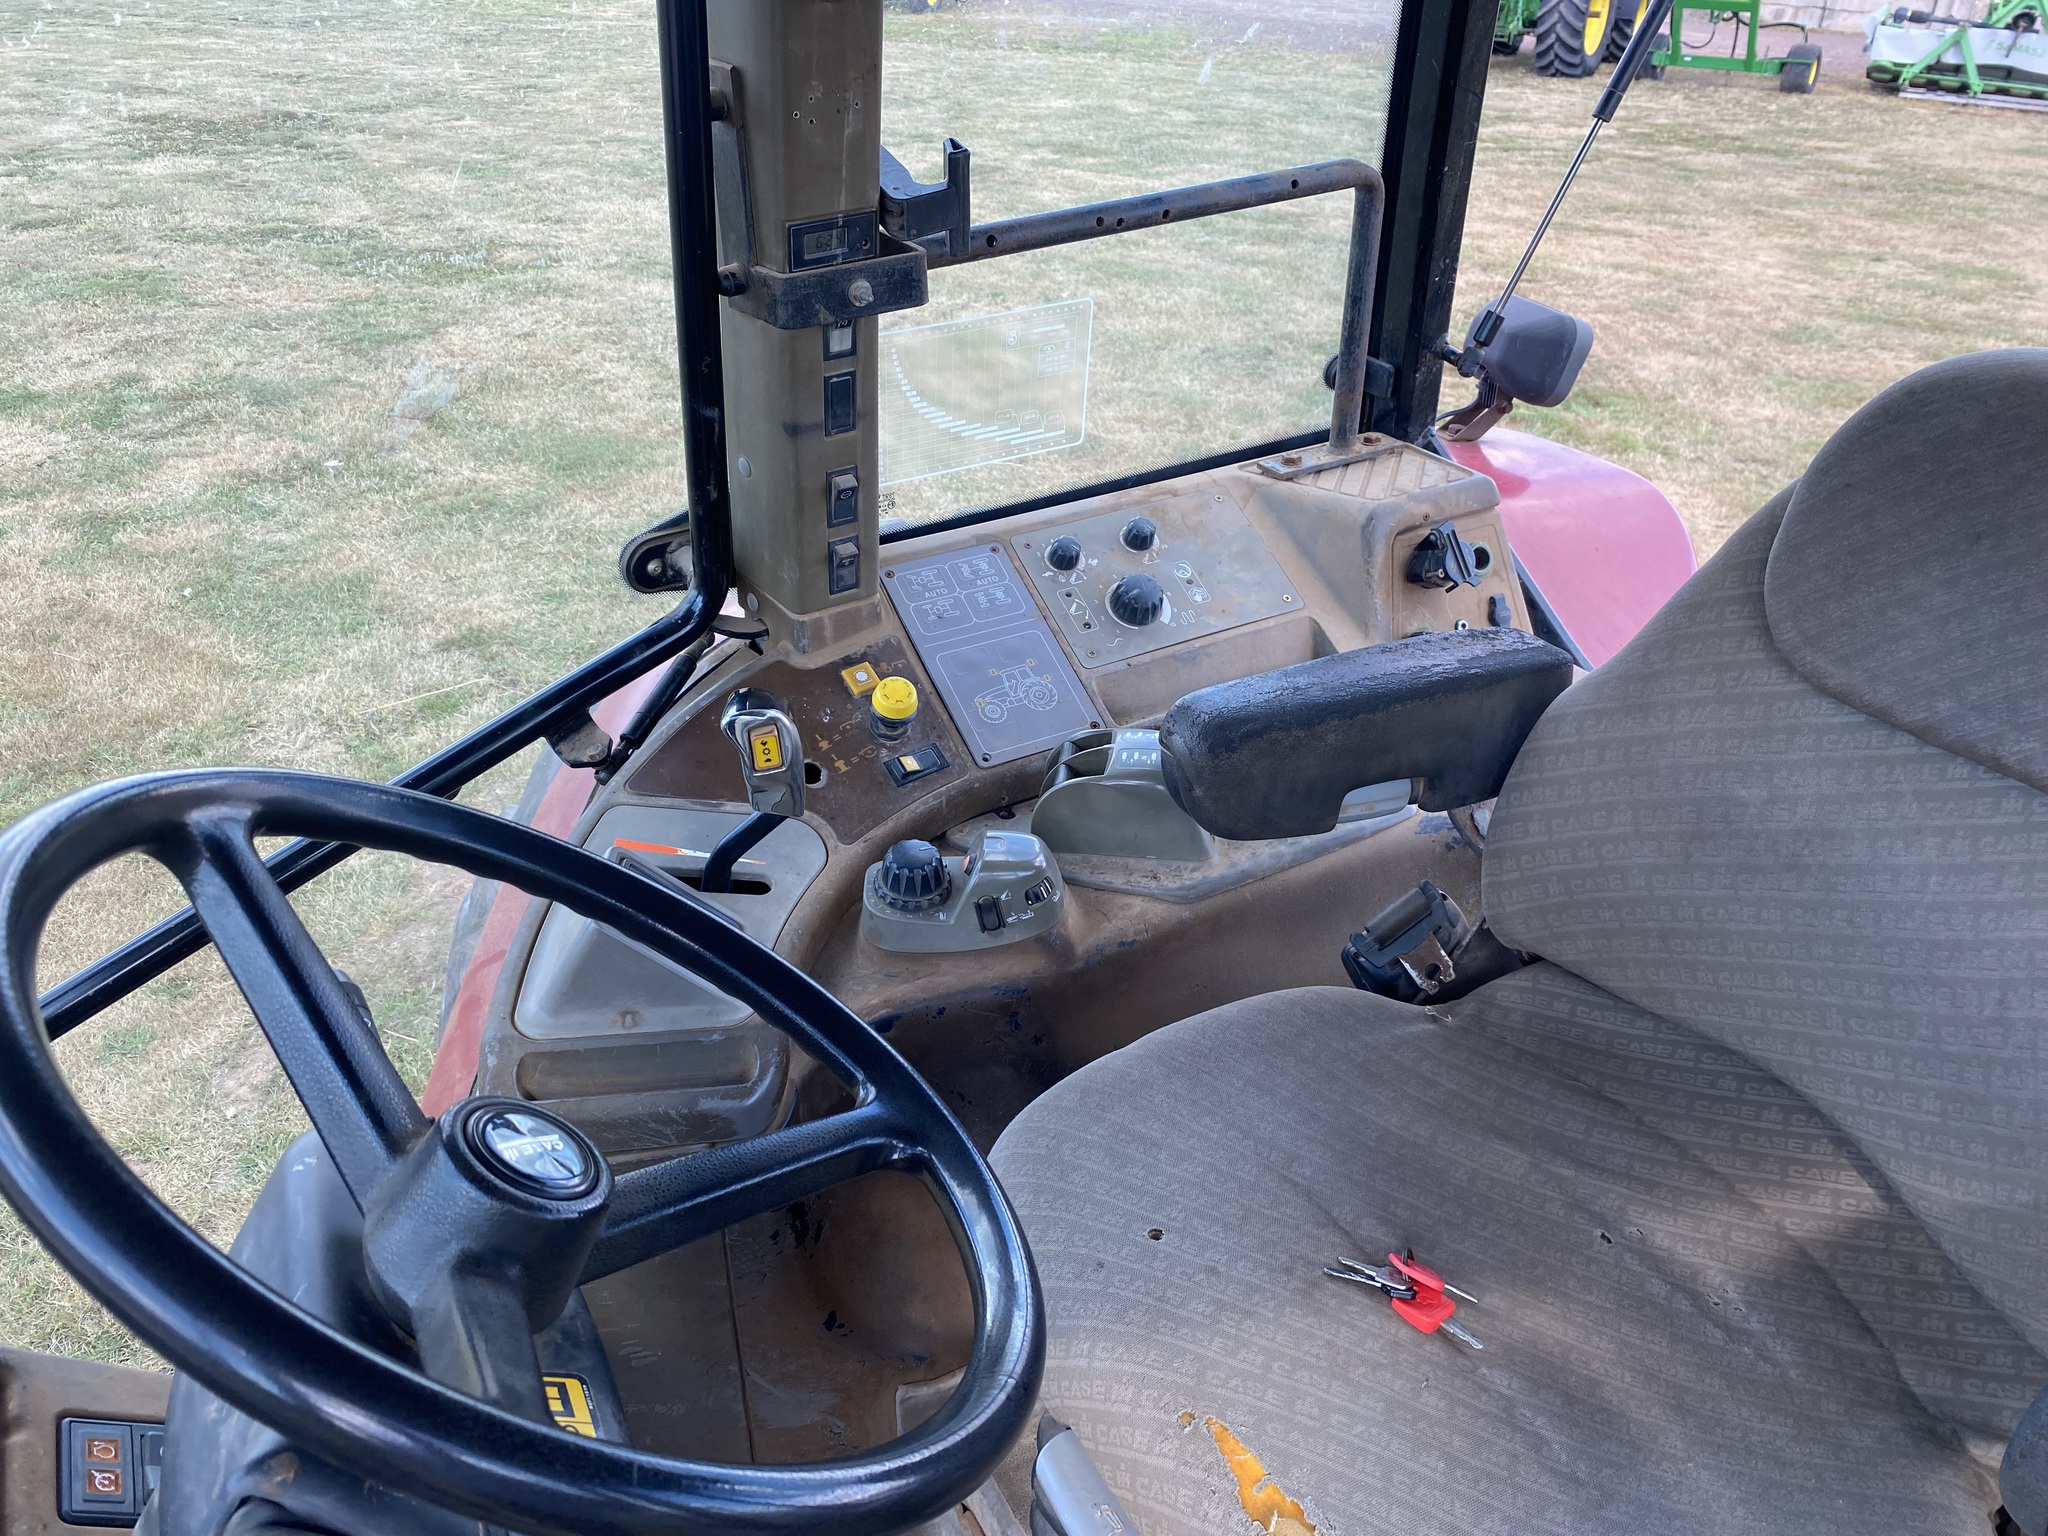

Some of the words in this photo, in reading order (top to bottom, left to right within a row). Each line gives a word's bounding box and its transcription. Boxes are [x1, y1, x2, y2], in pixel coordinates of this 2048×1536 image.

[925, 587, 948, 598] AUTO
[976, 575, 999, 586] AUTO
[1551, 811, 1608, 833] CASE
[1520, 847, 1573, 870] CASE
[1570, 874, 1623, 896] CASE
[1621, 904, 1672, 920] CASE
[1496, 991, 1548, 1007] CASE
[1576, 1006, 1631, 1028] CASE
[1530, 1018, 1585, 1040] CASE
[1613, 1038, 1672, 1058] CASE
[1566, 1047, 1623, 1072] CASE
[1652, 1067, 1713, 1089] CASE
[1816, 1045, 1869, 1067] CASE
[1604, 1081, 1664, 1104] CASE
[1695, 1100, 1757, 1120] CASE
[1861, 1087, 1917, 1111] CASE
[1504, 1097, 1562, 1126] CASE
[1592, 1127, 1654, 1153] CASE
[1788, 1165, 1857, 1185] CASE
[1645, 1114, 1704, 1138] CASE
[1738, 1132, 1806, 1157] CASE
[1633, 1161, 1699, 1185] CASE
[1734, 1182, 1803, 1205] CASE
[1840, 1197, 1910, 1219] CASE
[1784, 1216, 1856, 1238] CASE
[1731, 1230, 1799, 1254] CASE
[1838, 1252, 1910, 1274] CASE
[1894, 1285, 1972, 1307] CASE
[1901, 1340, 1979, 1365] CASE
[1062, 1379, 1106, 1400] CASE
[1097, 1424, 1152, 1450] CASE
[1136, 1476, 1196, 1514] CASE
